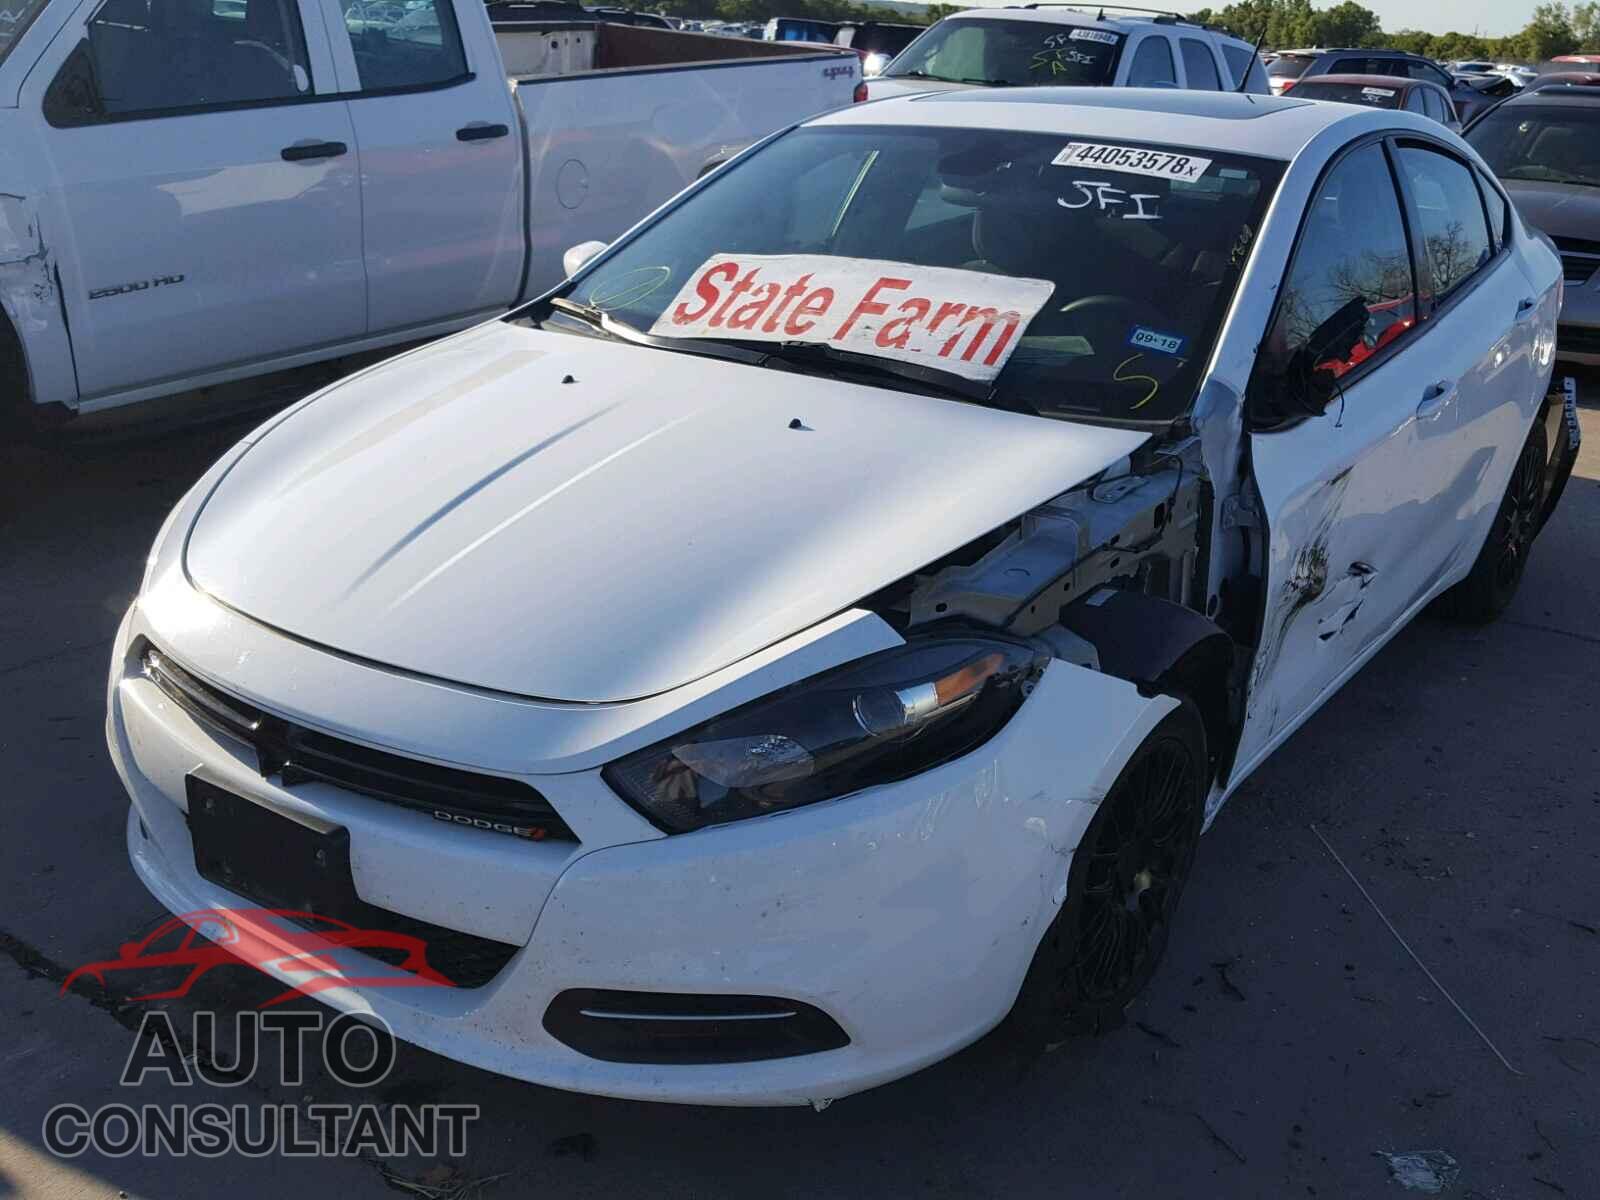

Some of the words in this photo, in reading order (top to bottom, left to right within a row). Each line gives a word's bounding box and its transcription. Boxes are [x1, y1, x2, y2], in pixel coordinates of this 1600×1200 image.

[672, 261, 835, 336] State
[832, 277, 1020, 365] Farm
[433, 810, 533, 837] DODGE
